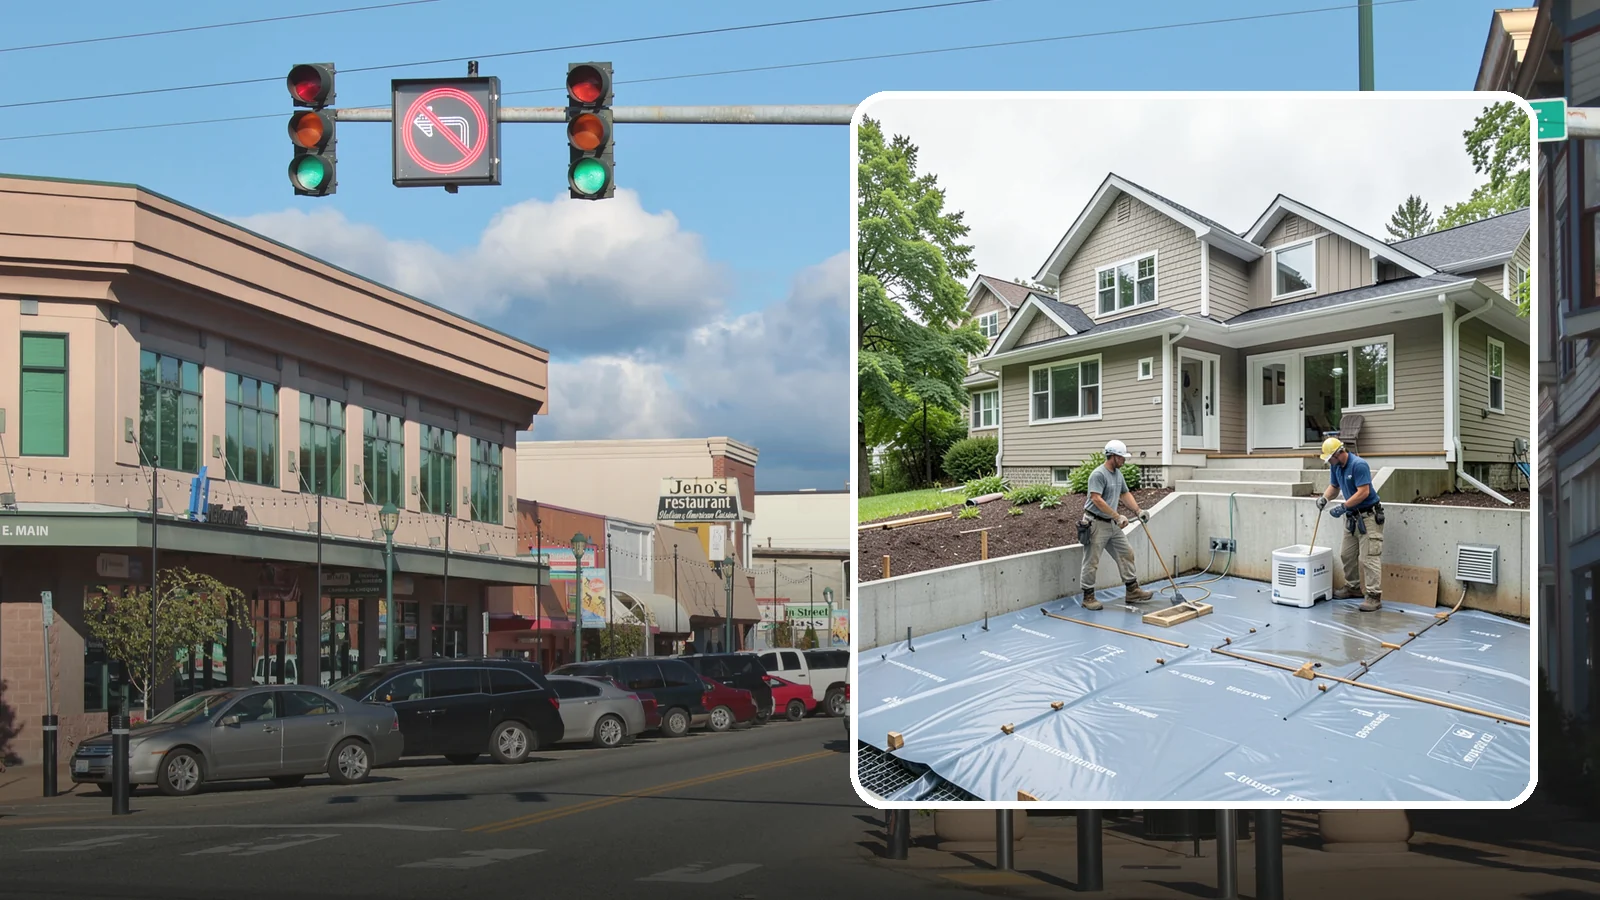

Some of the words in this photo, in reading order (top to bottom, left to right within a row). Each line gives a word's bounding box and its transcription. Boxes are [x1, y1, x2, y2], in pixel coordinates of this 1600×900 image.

[669, 480, 728, 495] Jeno's
[665, 496, 731, 509] restaurant
[658, 509, 682, 519] Italian
[686, 509, 714, 519] American
[714, 509, 738, 519] Cuisine
[2, 525, 13, 536] E.
[15, 525, 49, 536] MAIN
[797, 607, 828, 616] Street
